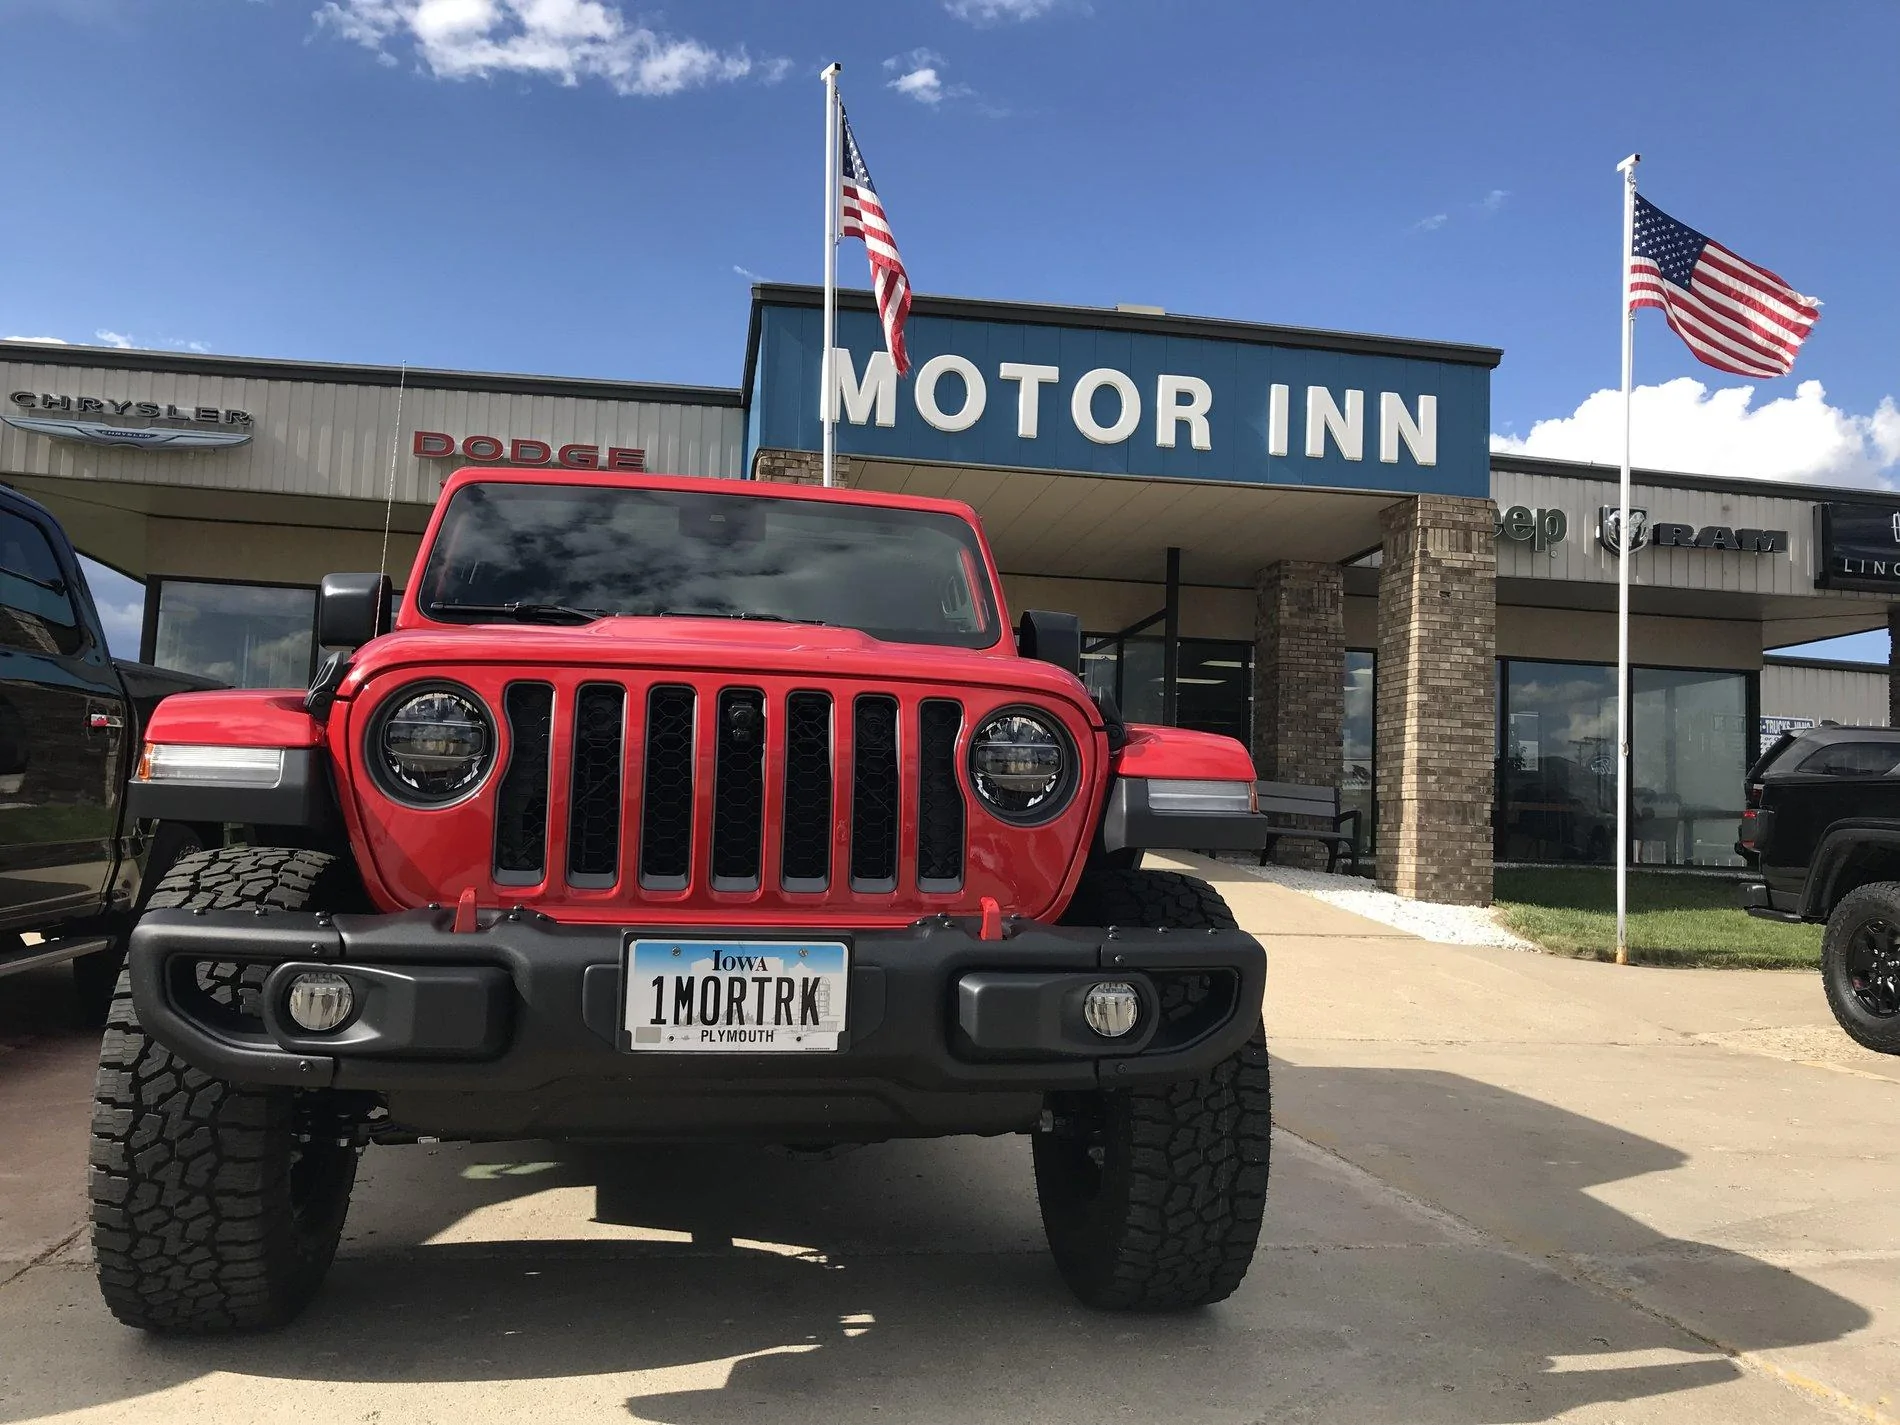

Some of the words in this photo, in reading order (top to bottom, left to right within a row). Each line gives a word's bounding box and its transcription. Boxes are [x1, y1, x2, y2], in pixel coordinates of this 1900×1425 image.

[10, 391, 252, 425] CHRYSLER
[820, 347, 1213, 451] MOTOR
[1269, 383, 1437, 466] INN
[413, 430, 646, 473] DODGE
[1495, 505, 1568, 552] ep
[1653, 522, 1789, 553] RAM
[650, 975, 821, 1026] 1MORTRK
[700, 1029, 774, 1043] PLYMOUTH
